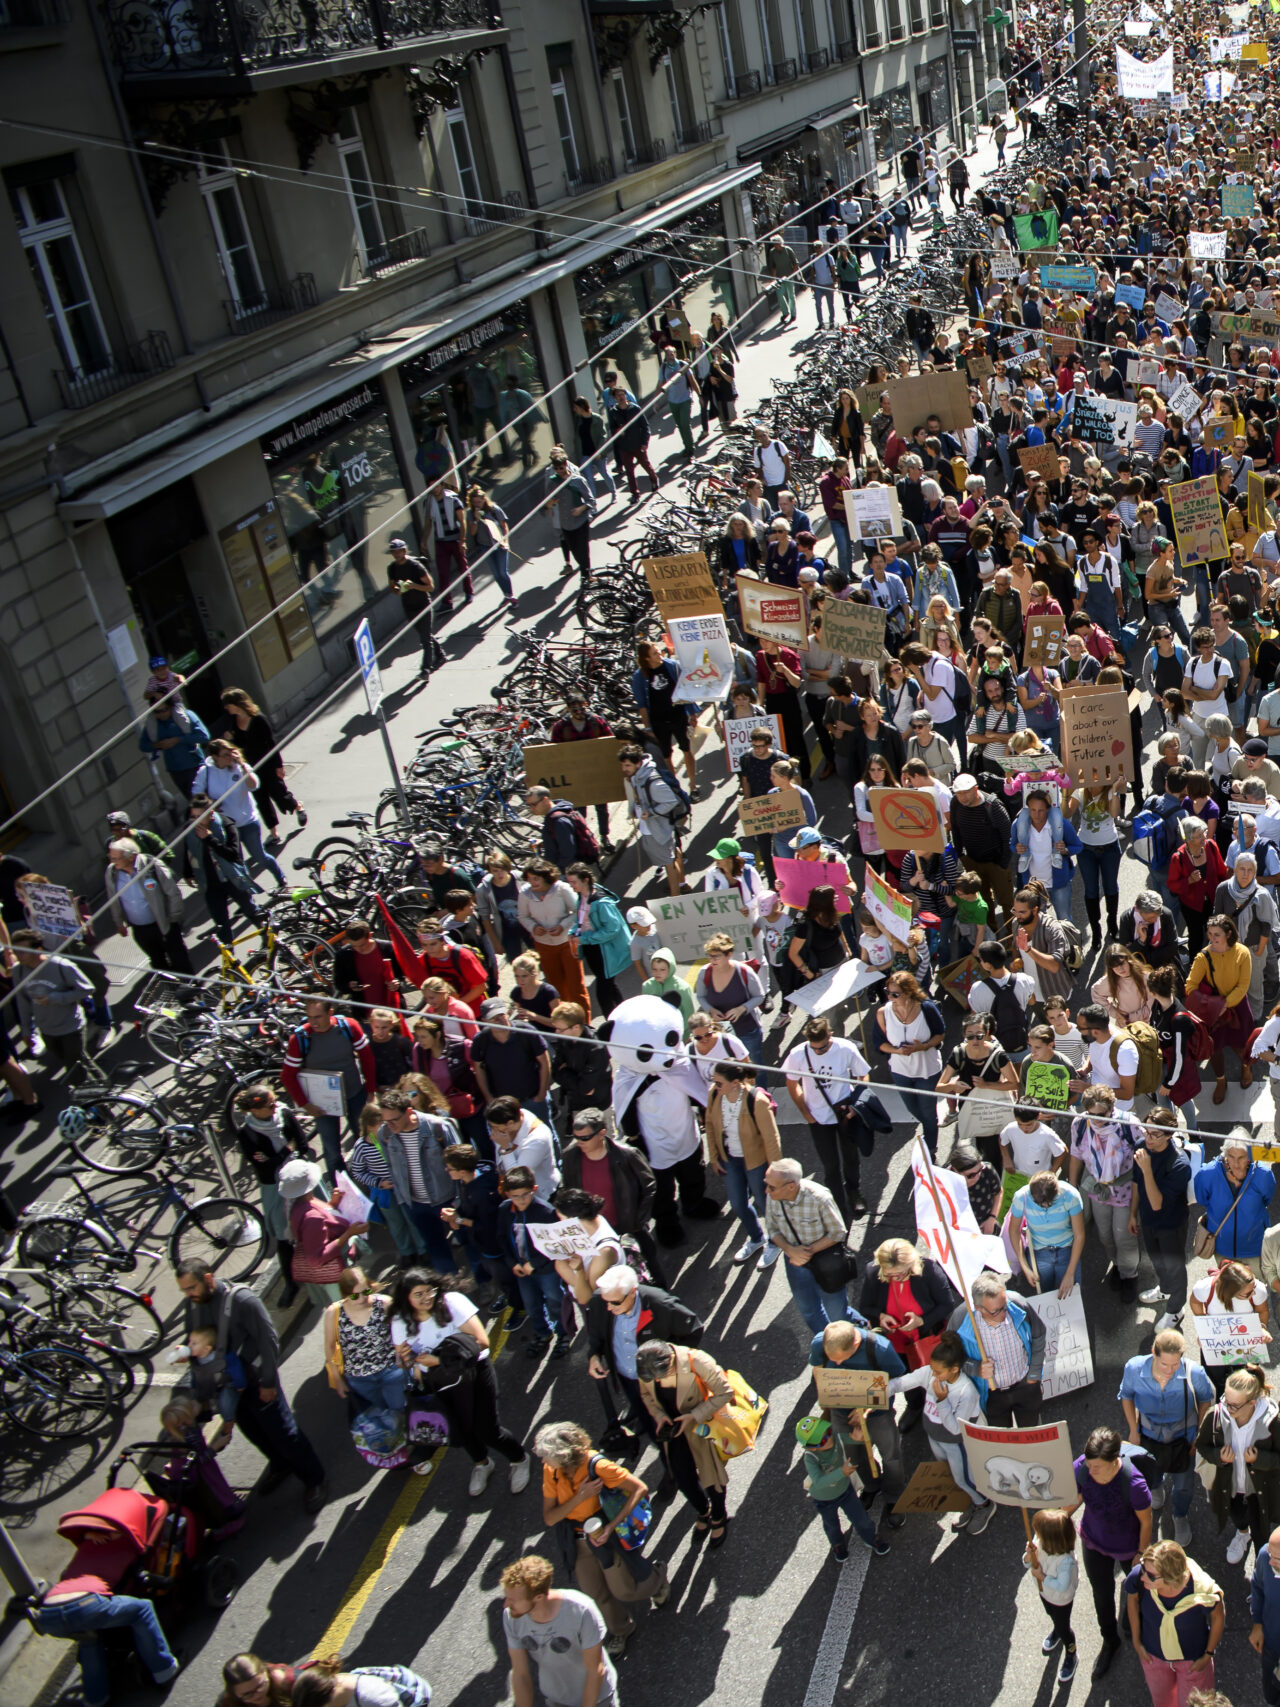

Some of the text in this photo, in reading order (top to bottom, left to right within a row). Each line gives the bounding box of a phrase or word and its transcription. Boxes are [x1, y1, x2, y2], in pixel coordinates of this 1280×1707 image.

[1007, 351, 1037, 367] MAISON
[1084, 419, 1117, 431] WALROSS
[1081, 429, 1113, 441] IN TOD
[1181, 480, 1207, 494] STOP
[265, 501, 275, 512] 21
[1183, 498, 1210, 510] START
[1178, 526, 1193, 534] WHY
[825, 600, 887, 625] ZUSAMMEN
[699, 618, 719, 629] ERDE
[702, 629, 725, 641] PIZZA
[866, 626, 883, 640] wir
[360, 634, 370, 673] P
[1072, 702, 1105, 715] I care
[745, 720, 756, 729] IST
[759, 717, 773, 726] DIE
[1072, 718, 1118, 730] about our
[1072, 730, 1113, 746] Children's
[1071, 748, 1105, 762] Future
[538, 775, 572, 788] ALL
[755, 798, 771, 807] THE
[753, 805, 783, 816] CHANGE
[744, 818, 756, 826] YOU
[757, 814, 777, 823] WANT
[786, 808, 799, 817] SEE
[762, 822, 775, 830] THE
[776, 817, 800, 827] WORLD
[660, 893, 740, 920] EN VERT
[1045, 1086, 1064, 1097] suis
[1262, 1150, 1277, 1160] 21
[1205, 1317, 1243, 1327] THERE
[1049, 1319, 1072, 1338] FOR
[1212, 1324, 1248, 1336] IS NO
[1205, 1338, 1241, 1349] THANK
[1213, 1347, 1259, 1358] FOR OUR
[1057, 1366, 1089, 1392] HOW
